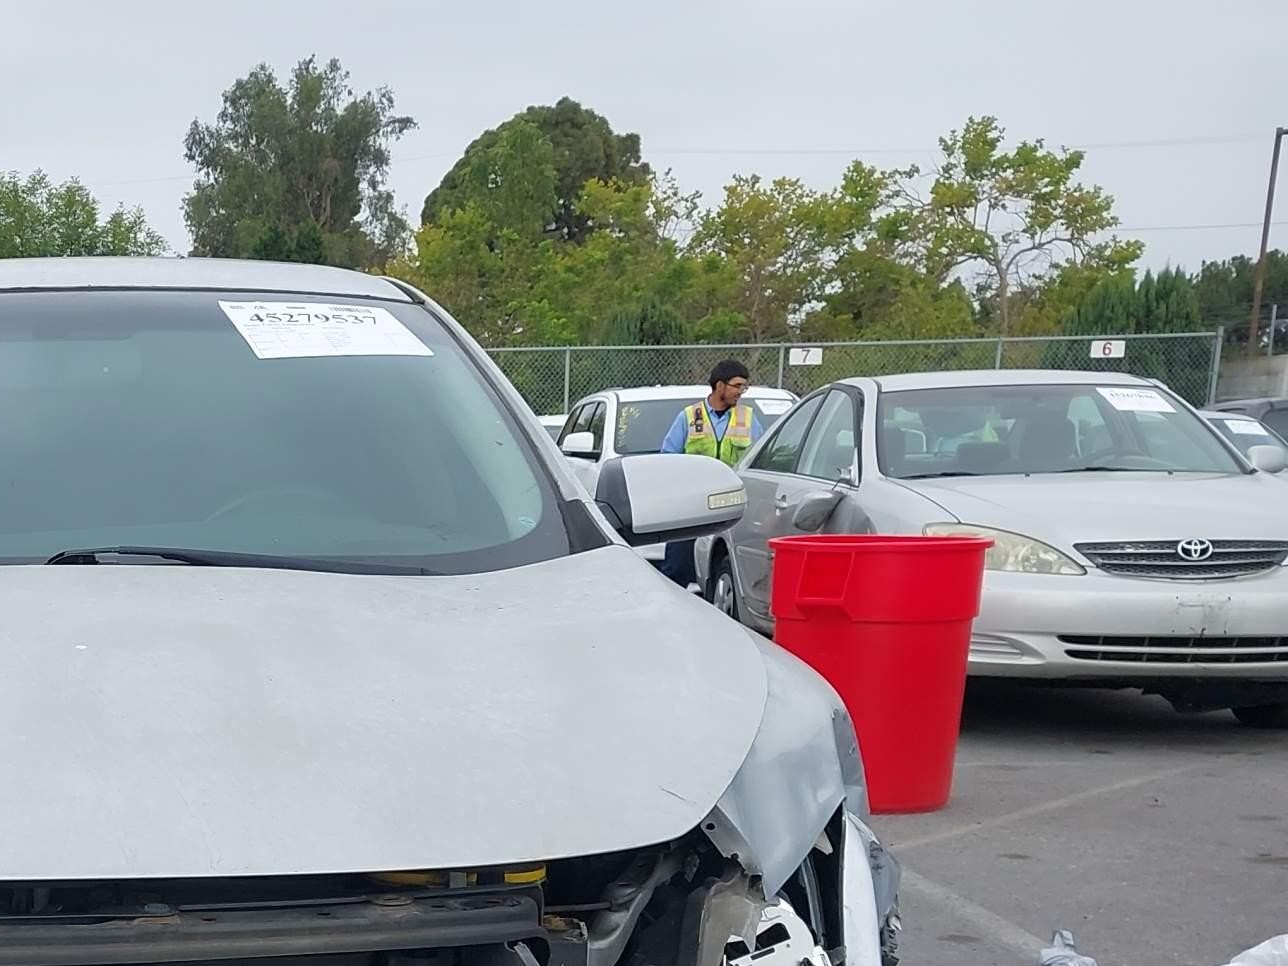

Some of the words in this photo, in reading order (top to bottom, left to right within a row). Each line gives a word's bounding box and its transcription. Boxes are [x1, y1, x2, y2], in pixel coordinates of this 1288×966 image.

[249, 312, 377, 325] 45279537
[1102, 341, 1112, 356] 6
[801, 349, 811, 363] 7
